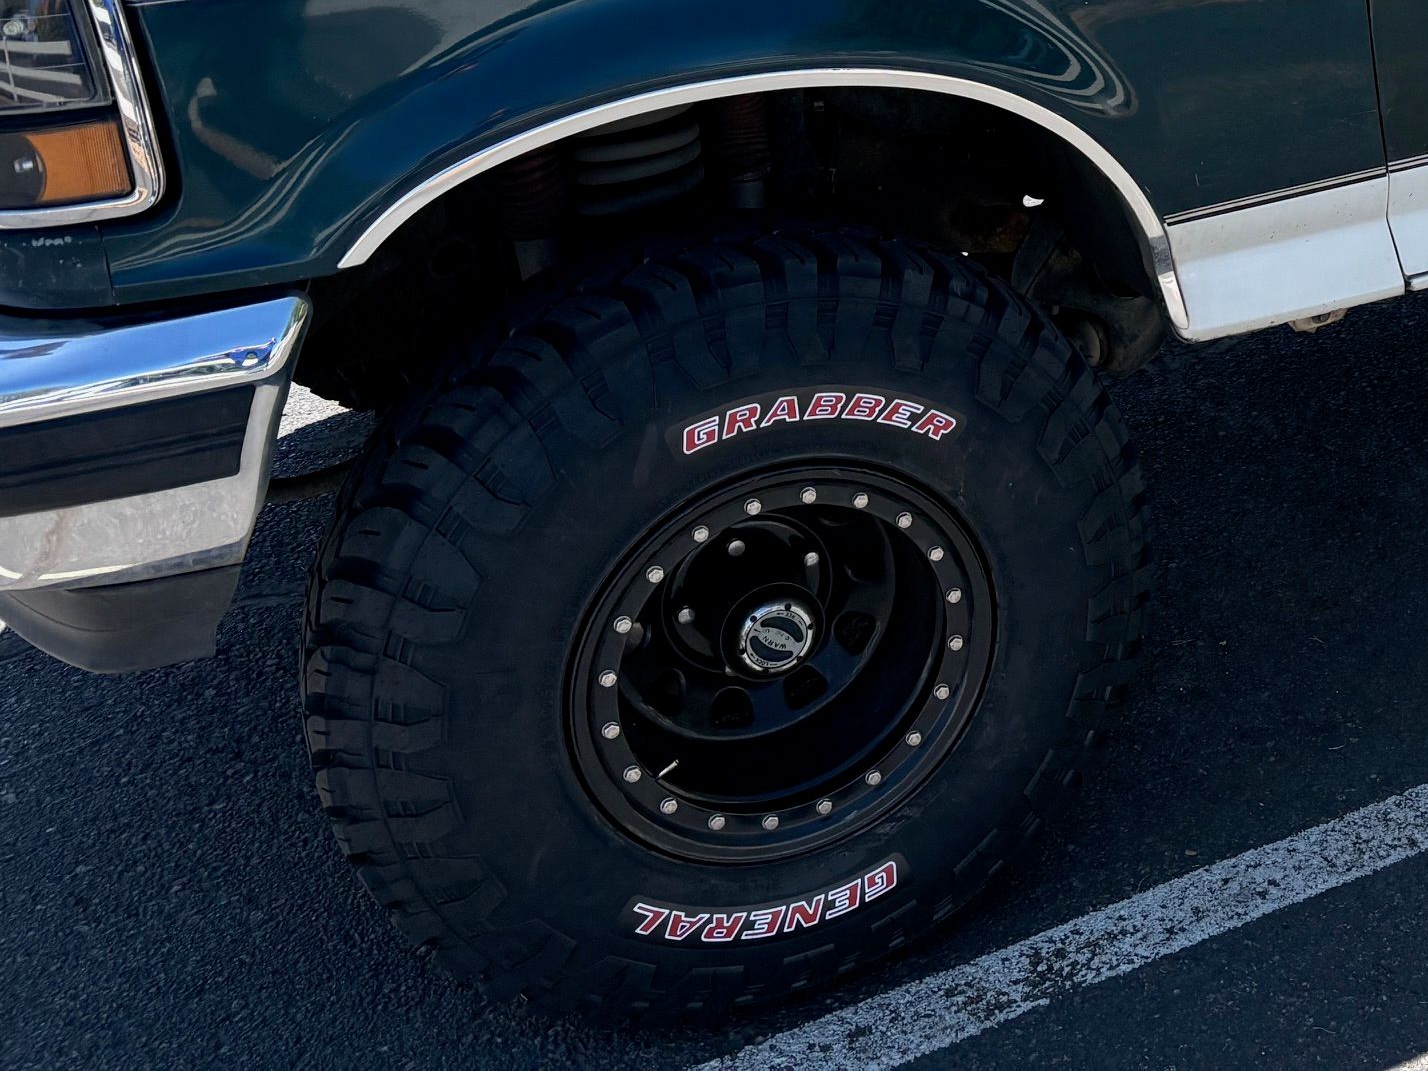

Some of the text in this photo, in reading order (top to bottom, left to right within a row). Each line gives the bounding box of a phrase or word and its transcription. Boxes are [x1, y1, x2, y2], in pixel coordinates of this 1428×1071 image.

[682, 392, 956, 455] GRABBER
[762, 635, 787, 650] WARN
[633, 860, 898, 942] GENERAL
